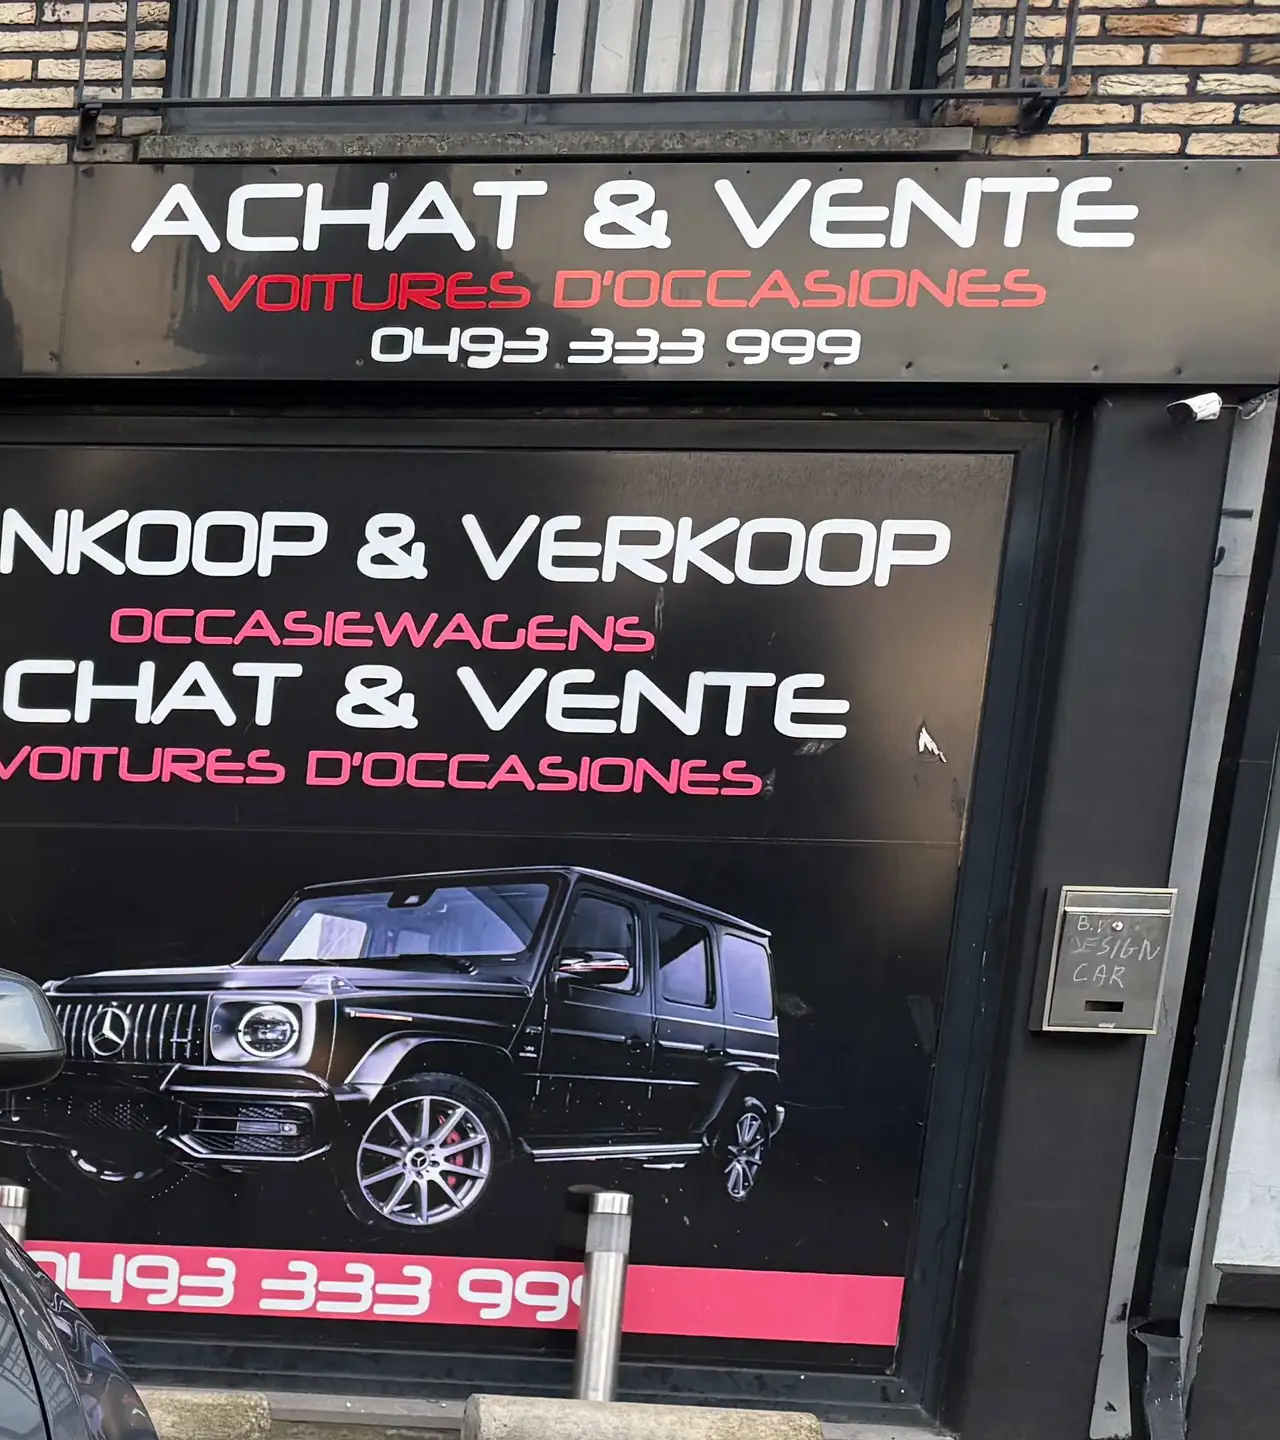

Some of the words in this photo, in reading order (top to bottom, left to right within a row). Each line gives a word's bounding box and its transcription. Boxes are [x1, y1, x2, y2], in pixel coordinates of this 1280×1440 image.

[129, 179, 550, 254] ACHAT
[582, 178, 673, 251] &
[712, 175, 1141, 250] VENTE
[206, 269, 534, 314] VOITURES
[551, 267, 1048, 311] D'OCCASIONES
[369, 325, 551, 370] 0493
[566, 326, 707, 366] 333
[724, 327, 863, 367] 999
[355, 511, 429, 581] &
[460, 512, 953, 588] VERKOOP
[109, 607, 657, 654] OCCASIEWAGENS
[334, 663, 420, 730] &
[455, 665, 851, 740] VENTE
[305, 749, 764, 797] D'OCCASIONES
[1072, 963, 1126, 989] CAR
[257, 1257, 434, 1317] 333
[456, 1266, 584, 1323] 99
